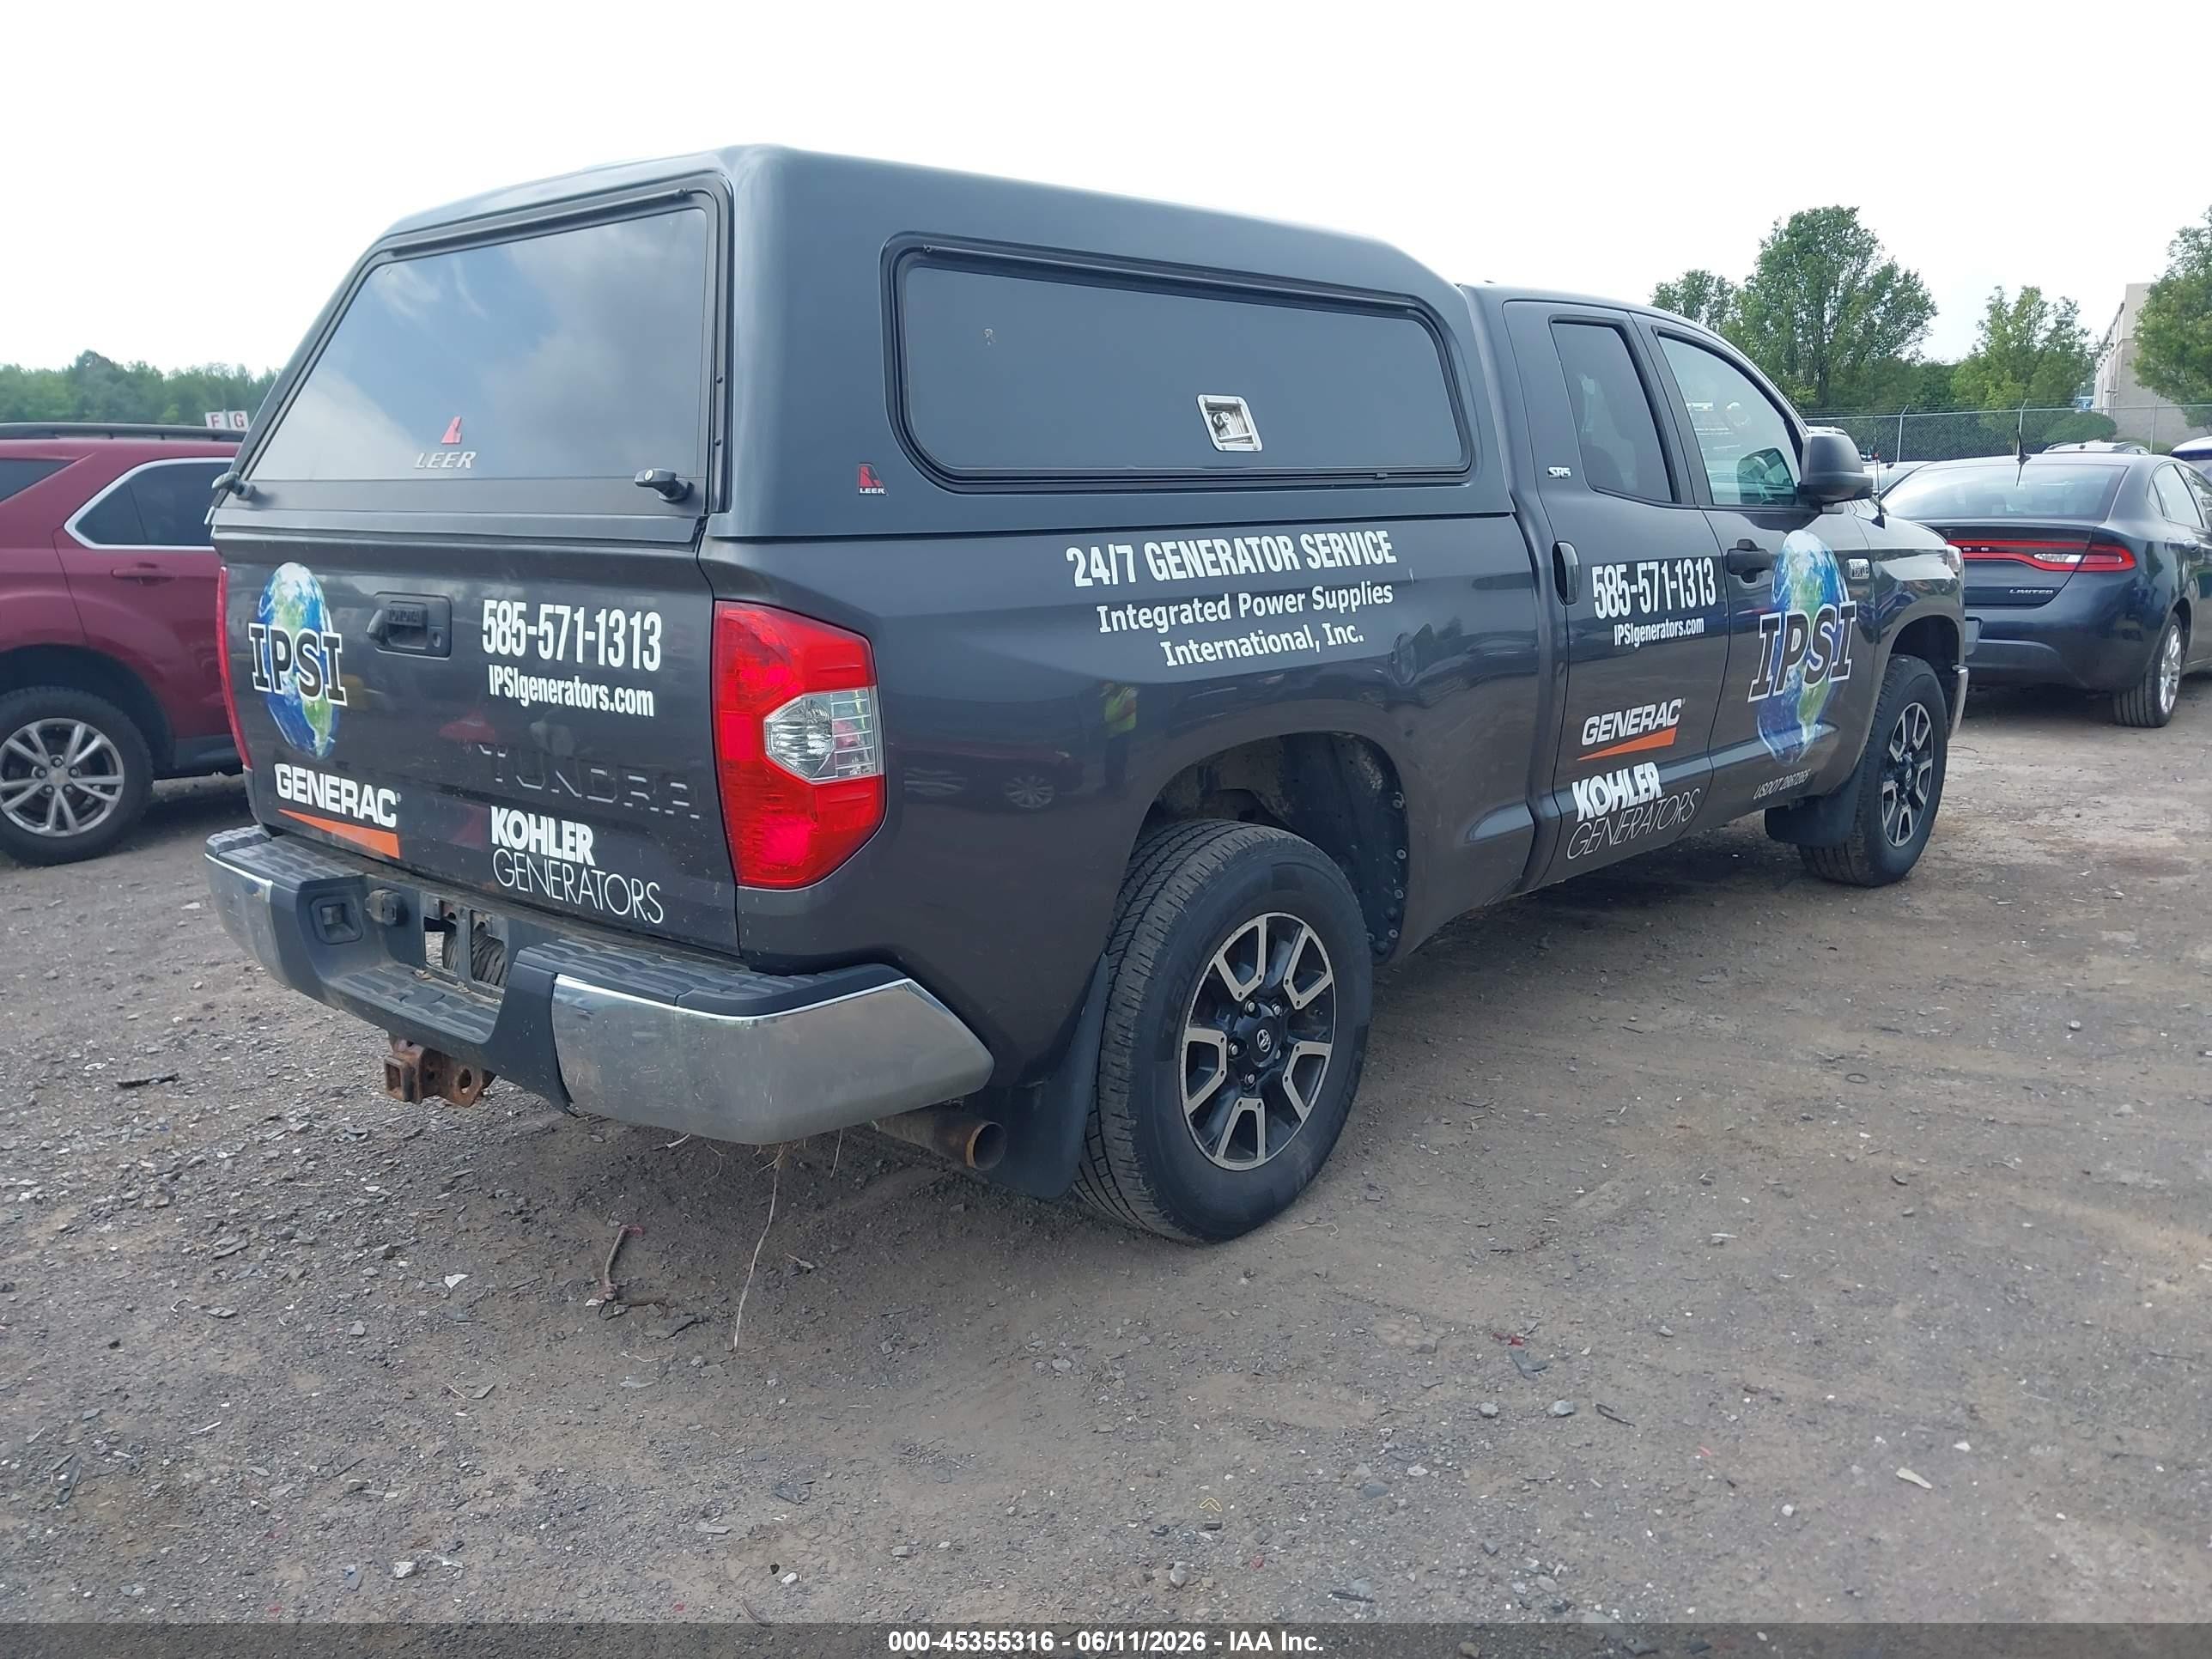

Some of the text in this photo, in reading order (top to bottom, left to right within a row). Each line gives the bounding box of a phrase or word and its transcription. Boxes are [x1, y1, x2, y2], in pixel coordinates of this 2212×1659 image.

[210, 414, 220, 428] F
[234, 412, 245, 428] G
[415, 451, 477, 469] LEER
[1066, 530, 1397, 587] 24/7 GENERATOR SERVICE
[1591, 557, 1717, 619] 585-571-1313
[482, 599, 662, 672] 585-571-1313
[1097, 580, 1394, 634] Integrated Power Supplies
[1613, 617, 1705, 647] IPSIgenerators.com
[247, 622, 348, 707] IPSI
[1159, 622, 1364, 667] International, Inc.
[1747, 600, 1856, 702] IPSI
[488, 664, 654, 717] IPSIgenerators.com
[1581, 698, 1682, 746] GENERAC
[274, 763, 397, 829] GENERAC
[478, 743, 700, 819] TUNDRA
[1571, 761, 1662, 823] KOHLER
[490, 805, 595, 866] KOHLER
[1566, 787, 1700, 860] GENERATORS
[493, 848, 664, 924] GENERATORS
